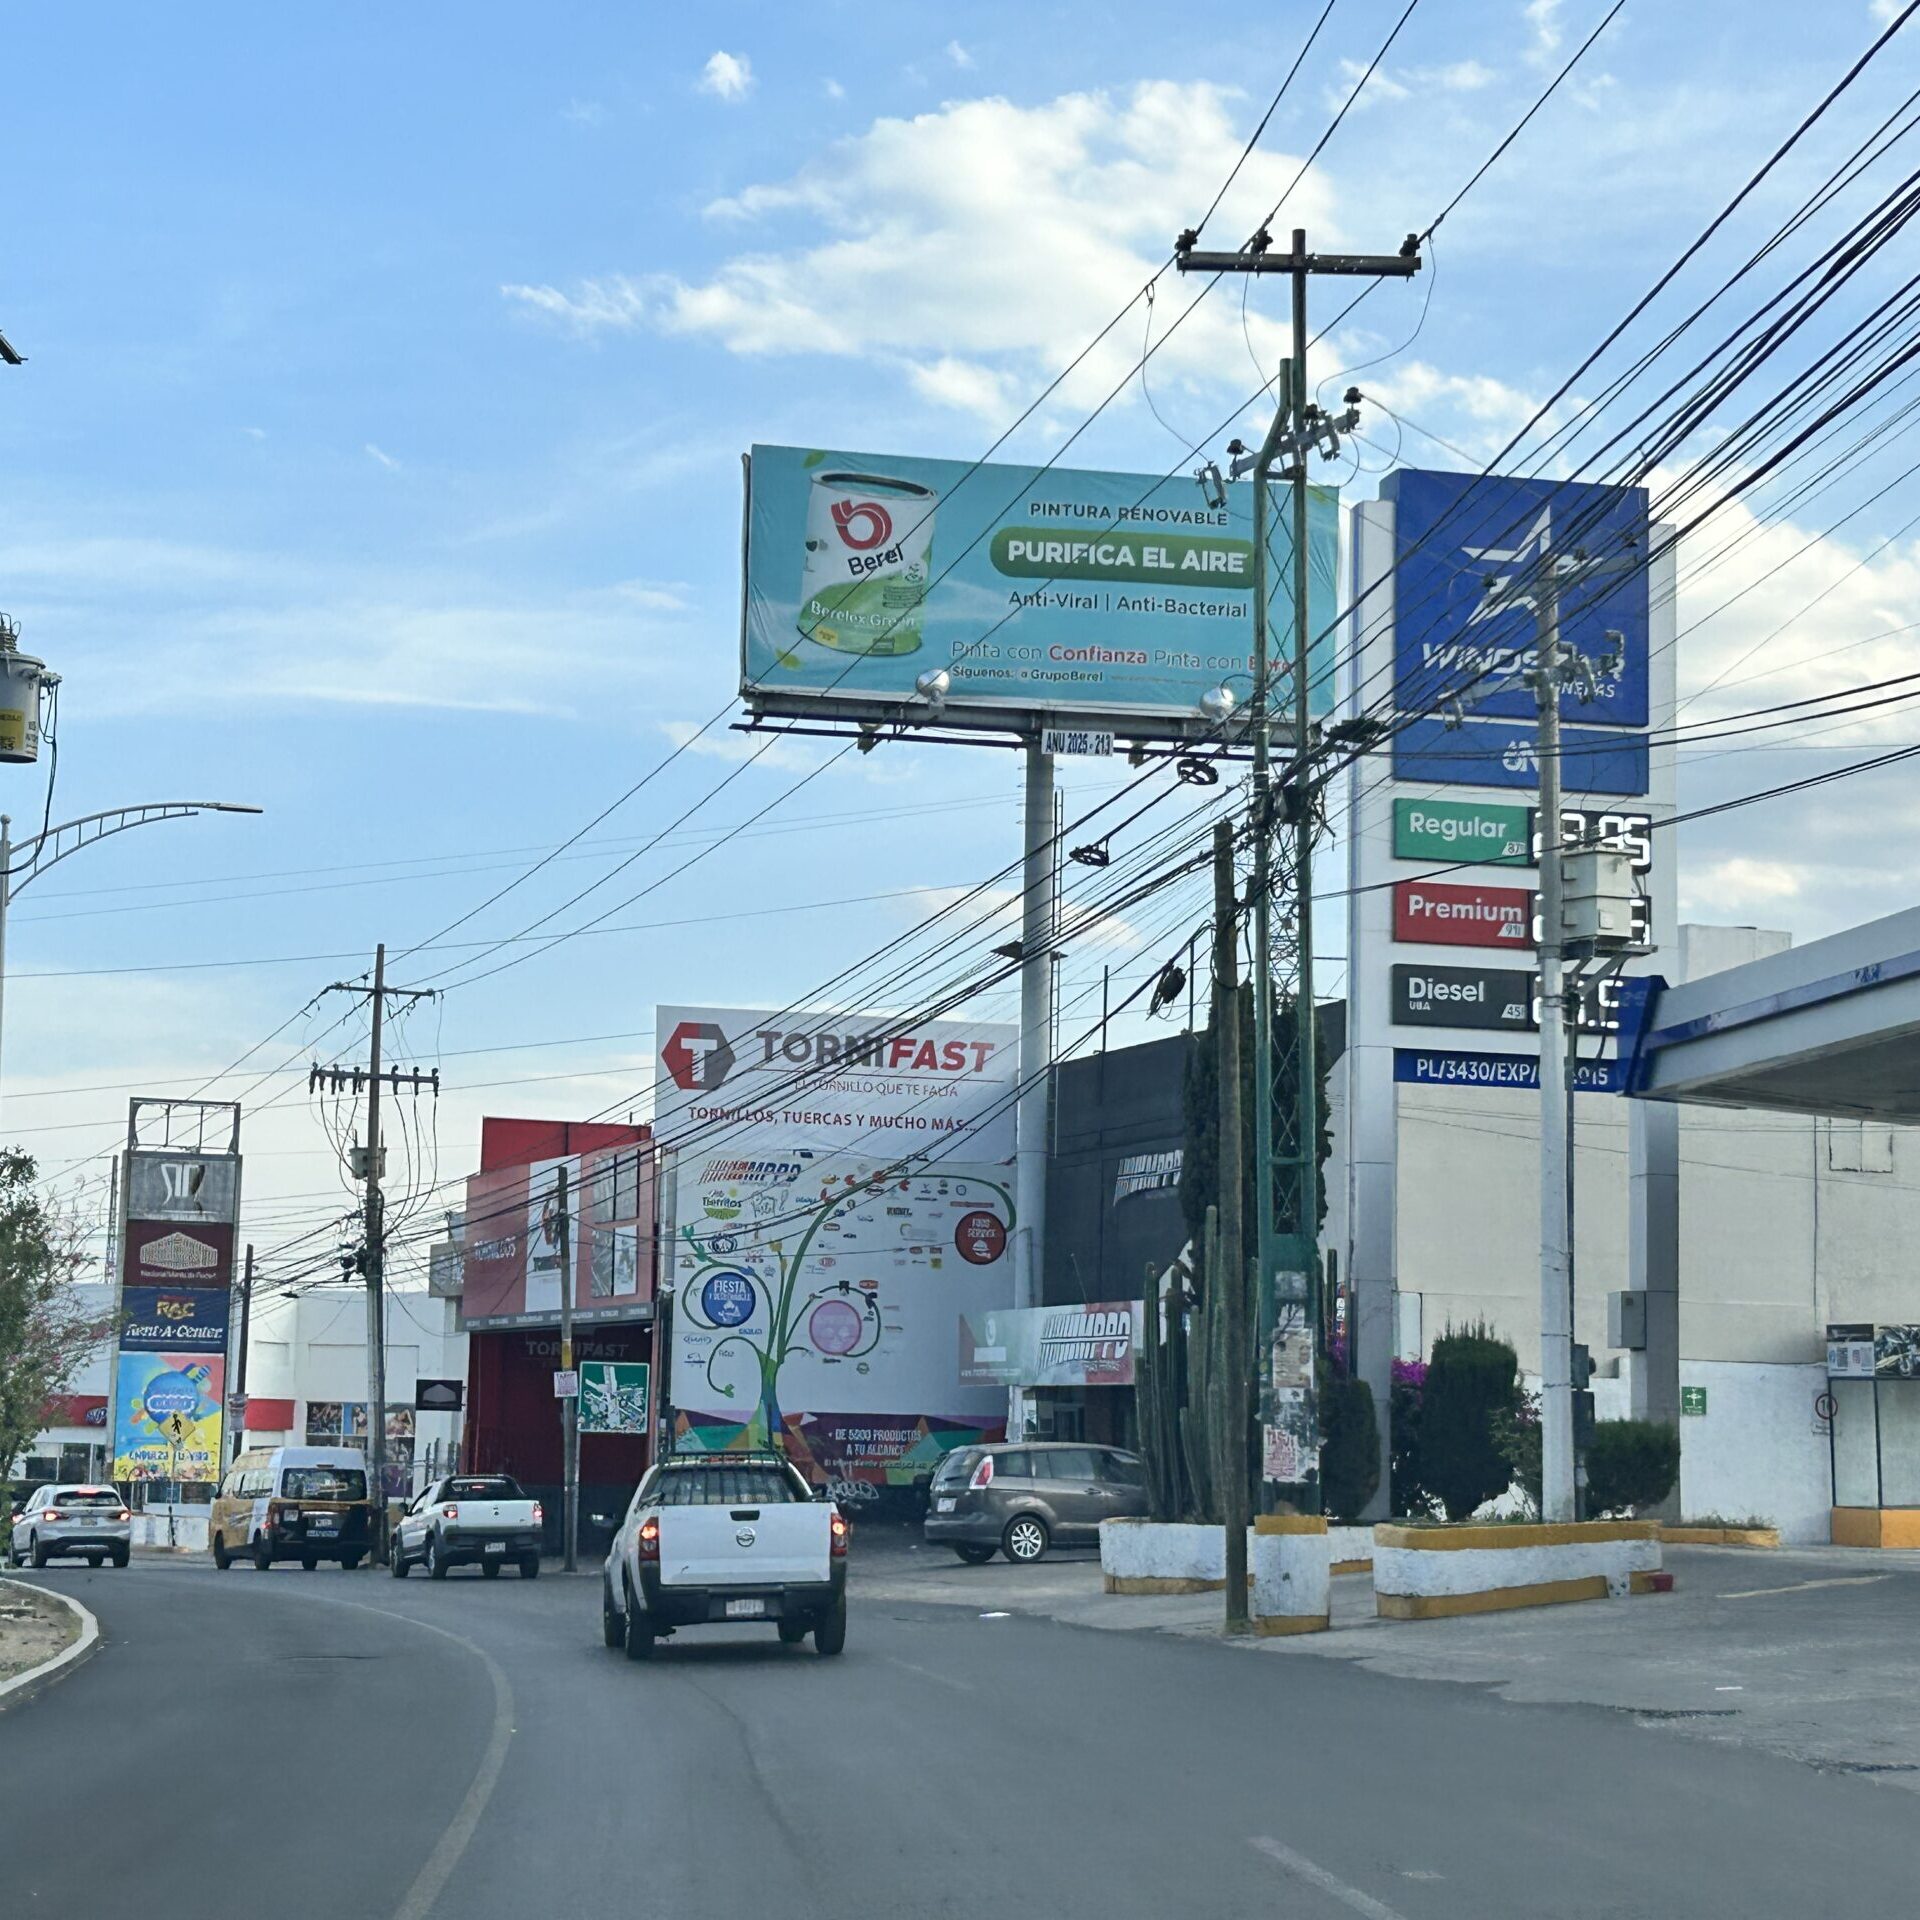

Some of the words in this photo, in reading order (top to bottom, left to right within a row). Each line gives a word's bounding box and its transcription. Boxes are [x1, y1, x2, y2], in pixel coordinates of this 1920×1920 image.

[1030, 503, 1111, 520] PINTURA
[1119, 507, 1228, 526] RENOVABLE
[848, 543, 903, 576] Berel
[1008, 540, 1136, 567] PURIFICA
[1142, 547, 1175, 569] EL
[1181, 550, 1248, 573] AIRE
[1009, 591, 1098, 609] Anti-Viral
[1117, 597, 1247, 617] Anti-Bacterial
[952, 641, 1000, 659] Pinta
[1007, 646, 1042, 660] con
[1049, 645, 1147, 664] Confianza
[1154, 650, 1200, 668] Pinta
[1206, 655, 1242, 670] con
[1045, 732, 1066, 753] ANU
[1410, 812, 1508, 842] Regular
[1408, 895, 1522, 922] Premium
[1408, 978, 1485, 1002] Diesel
[756, 1030, 995, 1072] TORNIFAST
[812, 1078, 873, 1093] TORNILLO
[876, 1082, 903, 1096] QUE
[906, 1084, 919, 1095] TE
[688, 1106, 778, 1125] TORNILLOS,
[783, 1111, 852, 1126] TUERCAS
[856, 1115, 865, 1127] Y
[869, 1115, 927, 1130] MUCHO
[714, 1280, 746, 1293] FIESTA
[873, 1429, 922, 1441] PRODUCTOS
